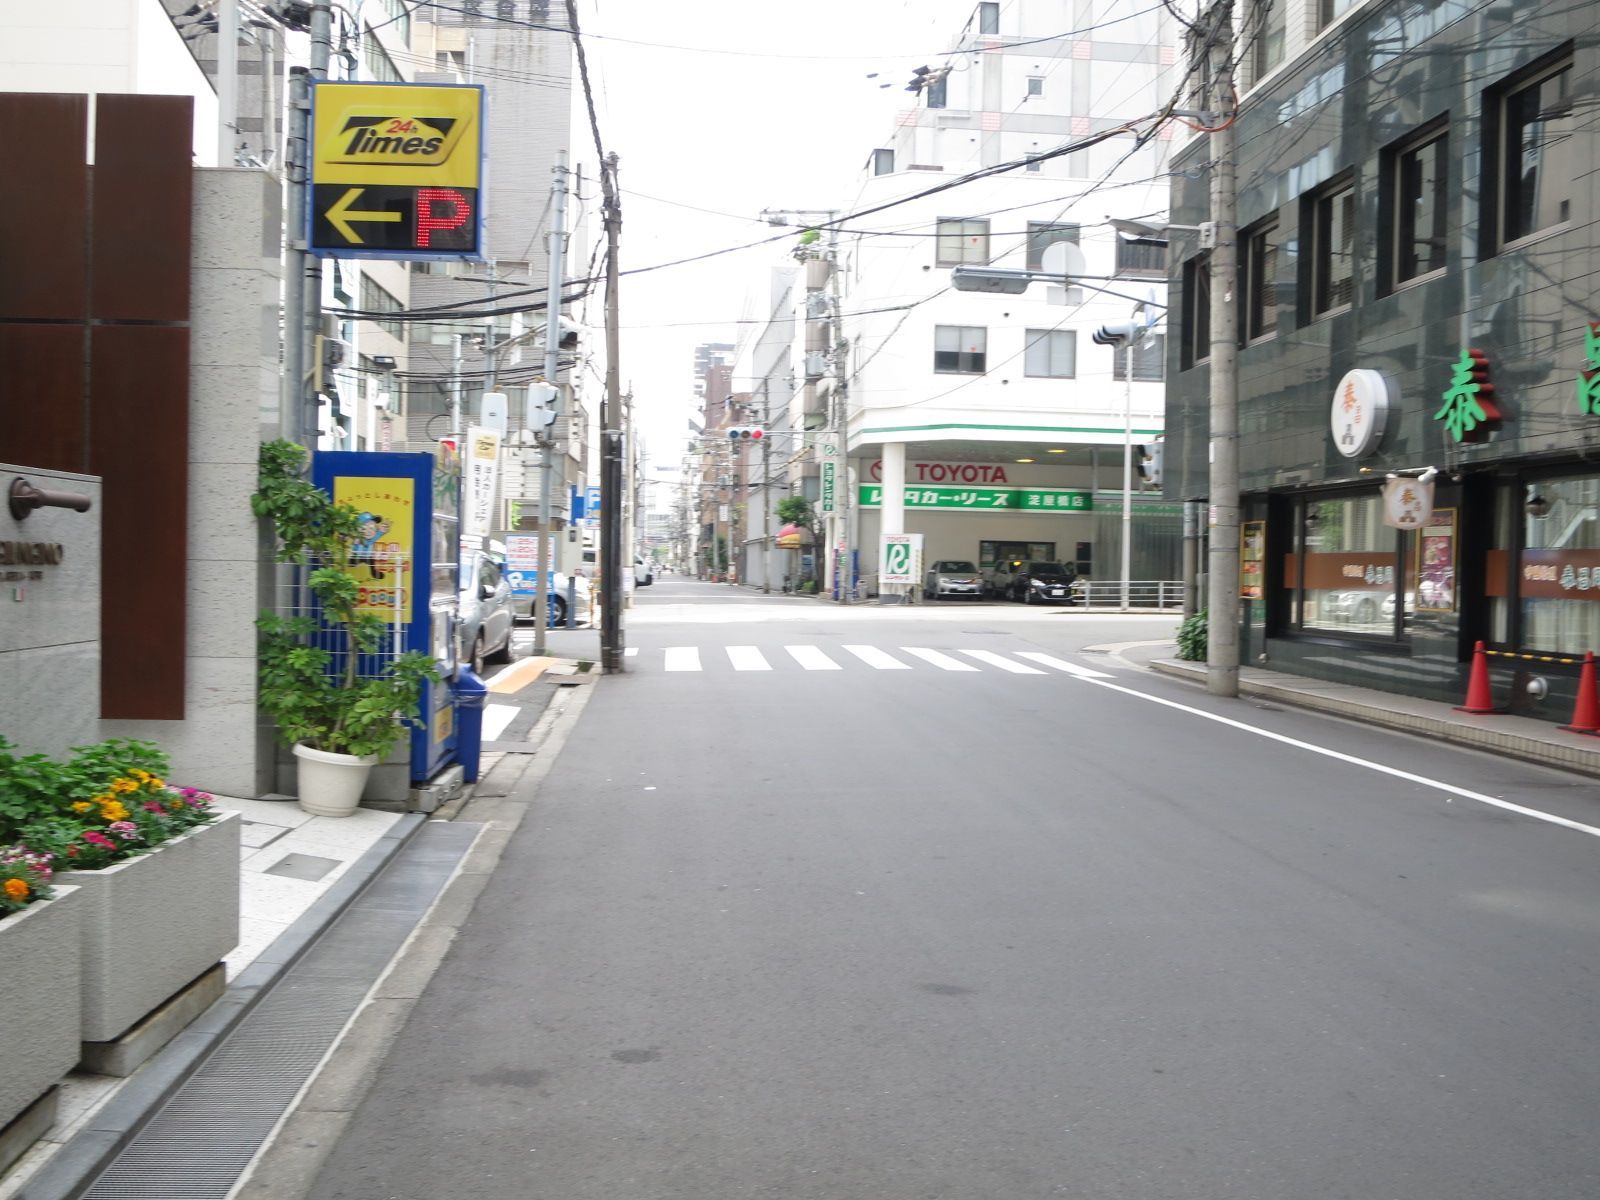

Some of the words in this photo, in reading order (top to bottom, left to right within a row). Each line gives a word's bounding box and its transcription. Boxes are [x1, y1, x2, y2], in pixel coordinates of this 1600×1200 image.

[345, 127, 443, 156] Times
[417, 188, 470, 247] P
[915, 463, 1008, 484] TOYOTA
[870, 488, 1010, 507] レタカー・リース
